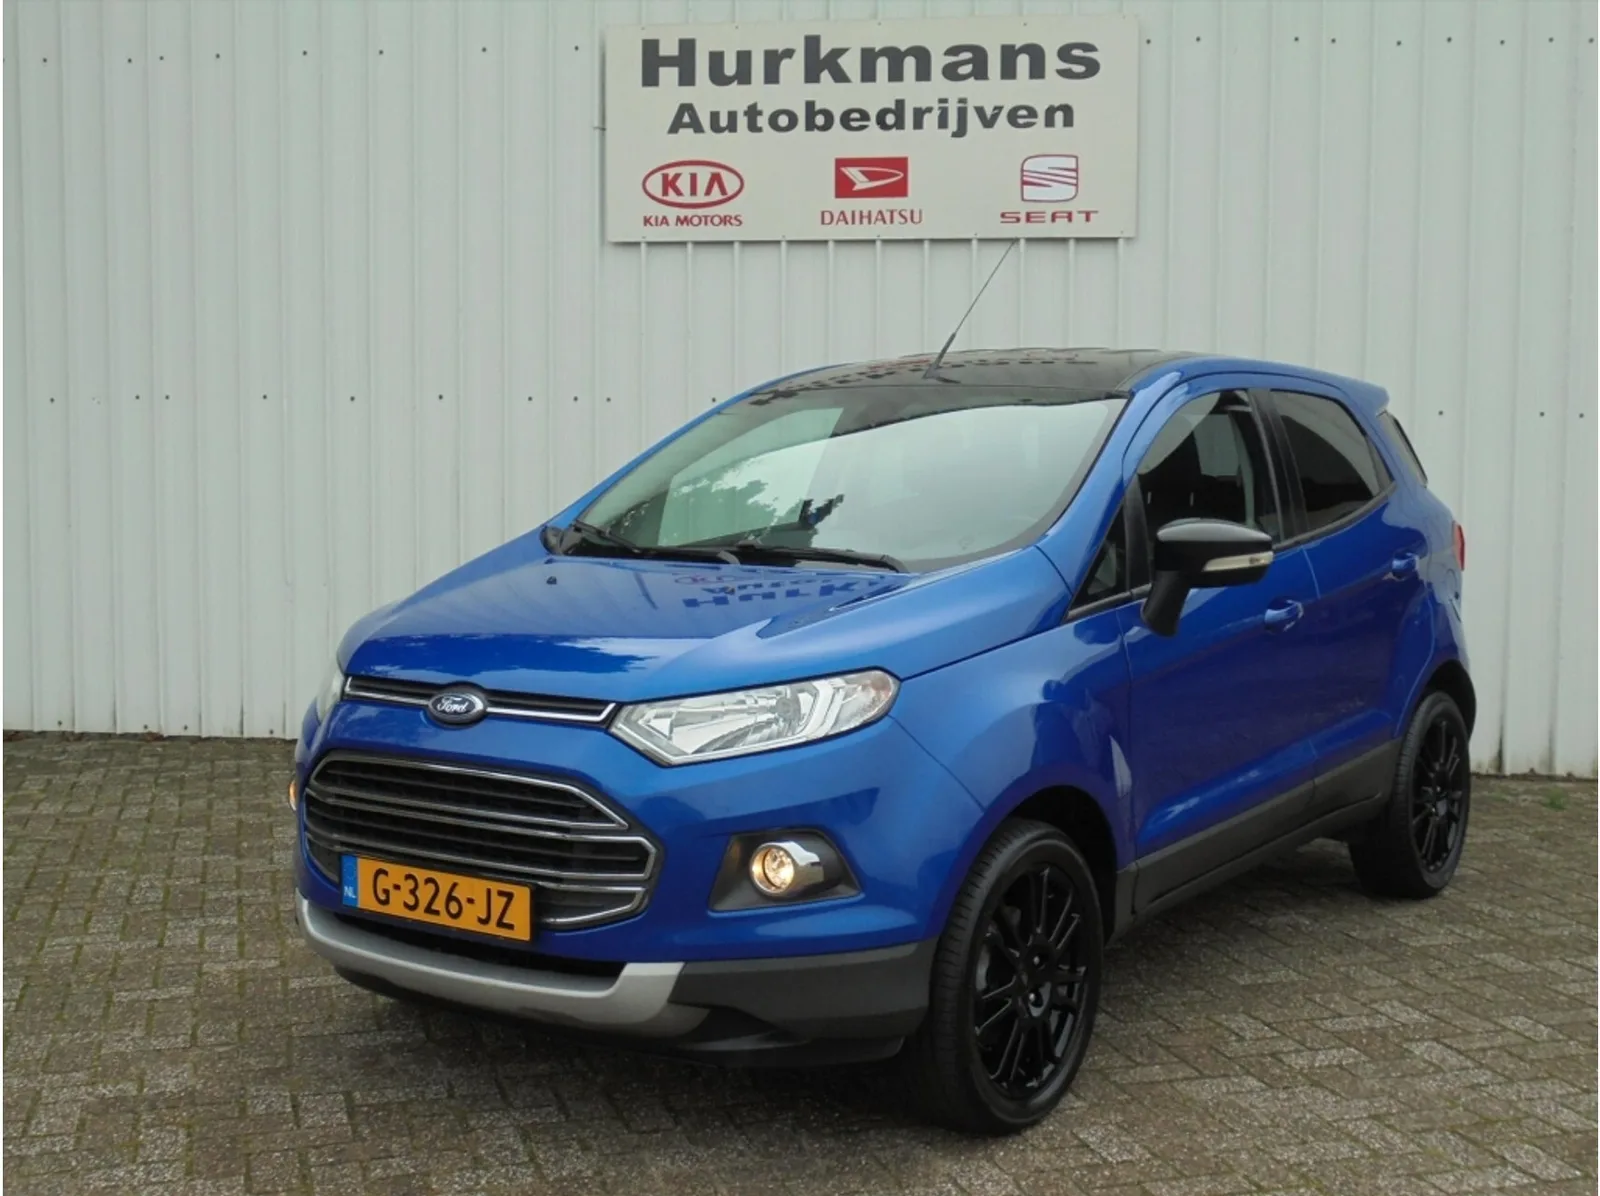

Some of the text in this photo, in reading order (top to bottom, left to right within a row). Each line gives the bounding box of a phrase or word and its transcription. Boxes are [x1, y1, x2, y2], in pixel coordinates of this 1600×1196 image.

[641, 34, 1101, 87] Hurkmans
[667, 97, 1075, 138] Autobedrijven
[661, 172, 728, 197] KIA
[643, 214, 743, 227] KIA MOTORS
[820, 209, 923, 226] DAIHATSU
[1000, 210, 1099, 224] SEAT
[436, 694, 471, 714] Ford
[344, 885, 357, 898] NL
[372, 867, 516, 931] G-326-JZ
